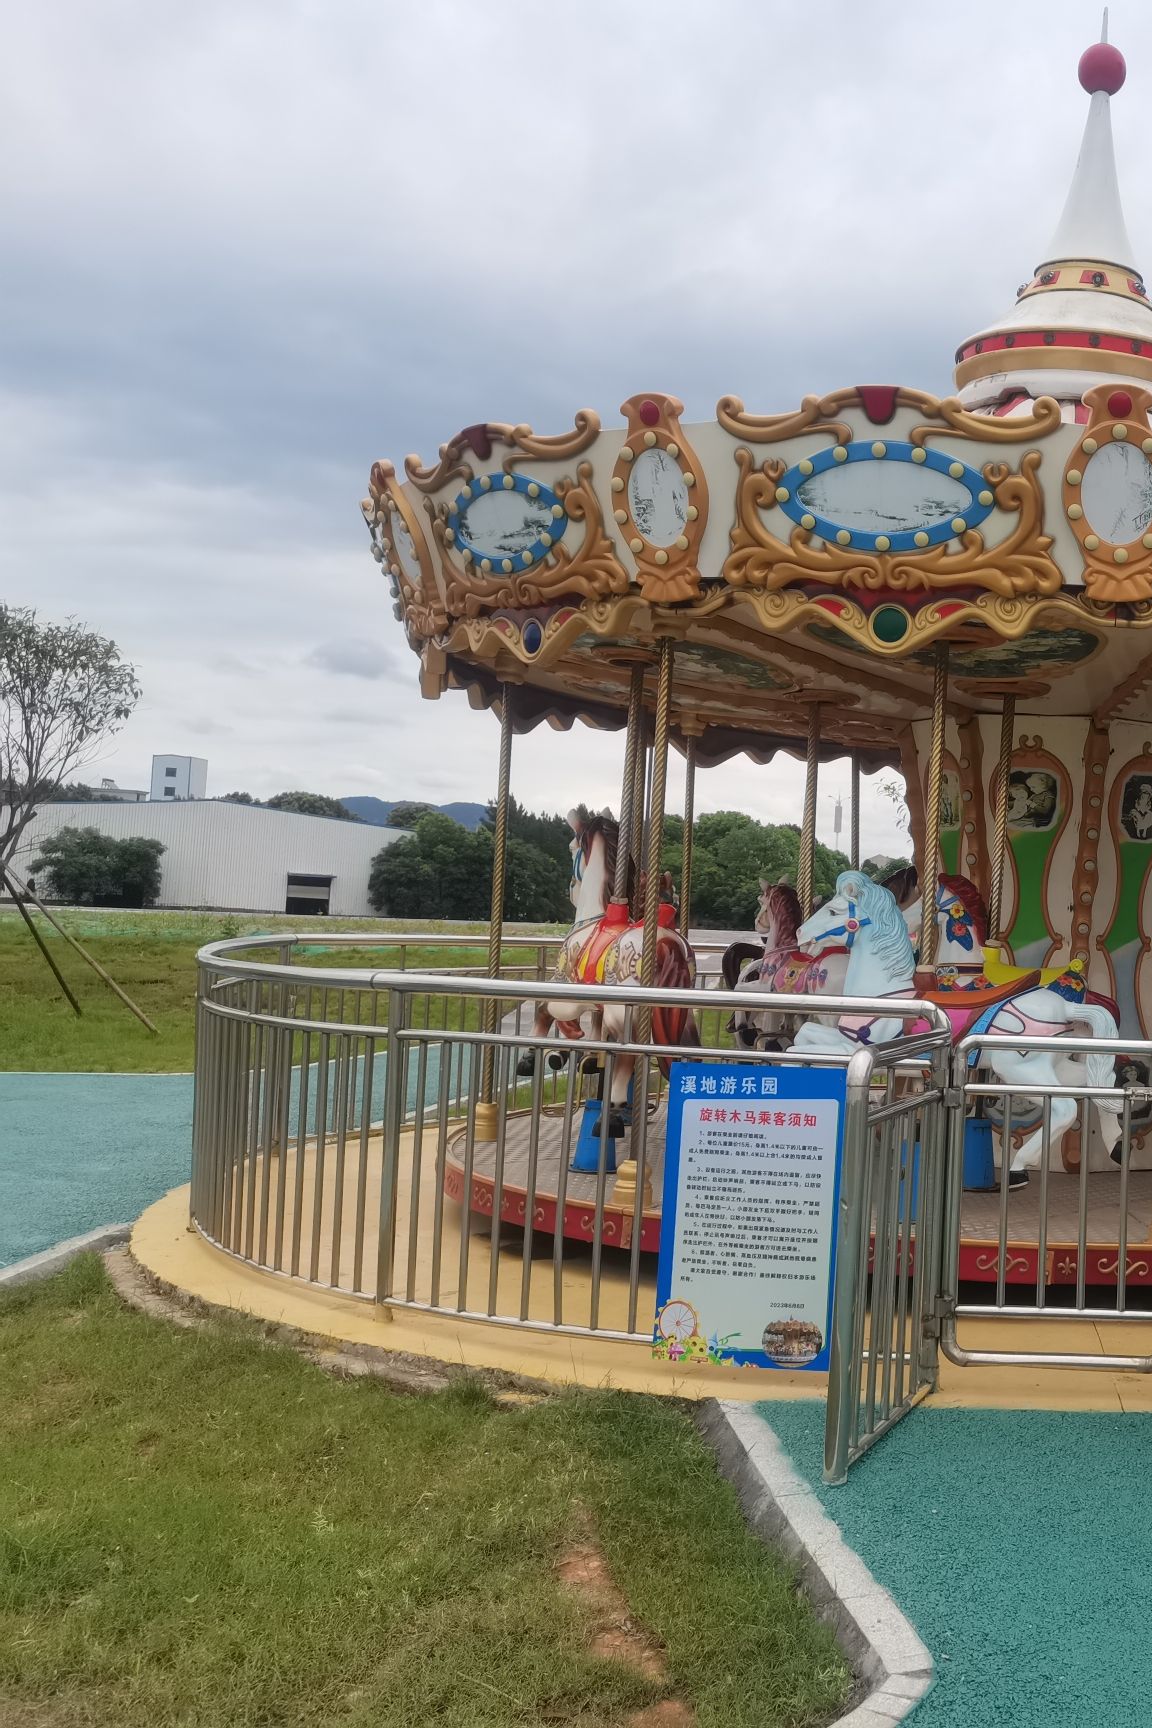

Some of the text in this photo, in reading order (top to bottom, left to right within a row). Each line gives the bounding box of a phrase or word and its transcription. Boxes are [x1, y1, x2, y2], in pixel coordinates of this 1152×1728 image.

[680, 1075, 778, 1095] 溪地游乐园
[699, 1108, 817, 1127] 旋转木马乘客须知
